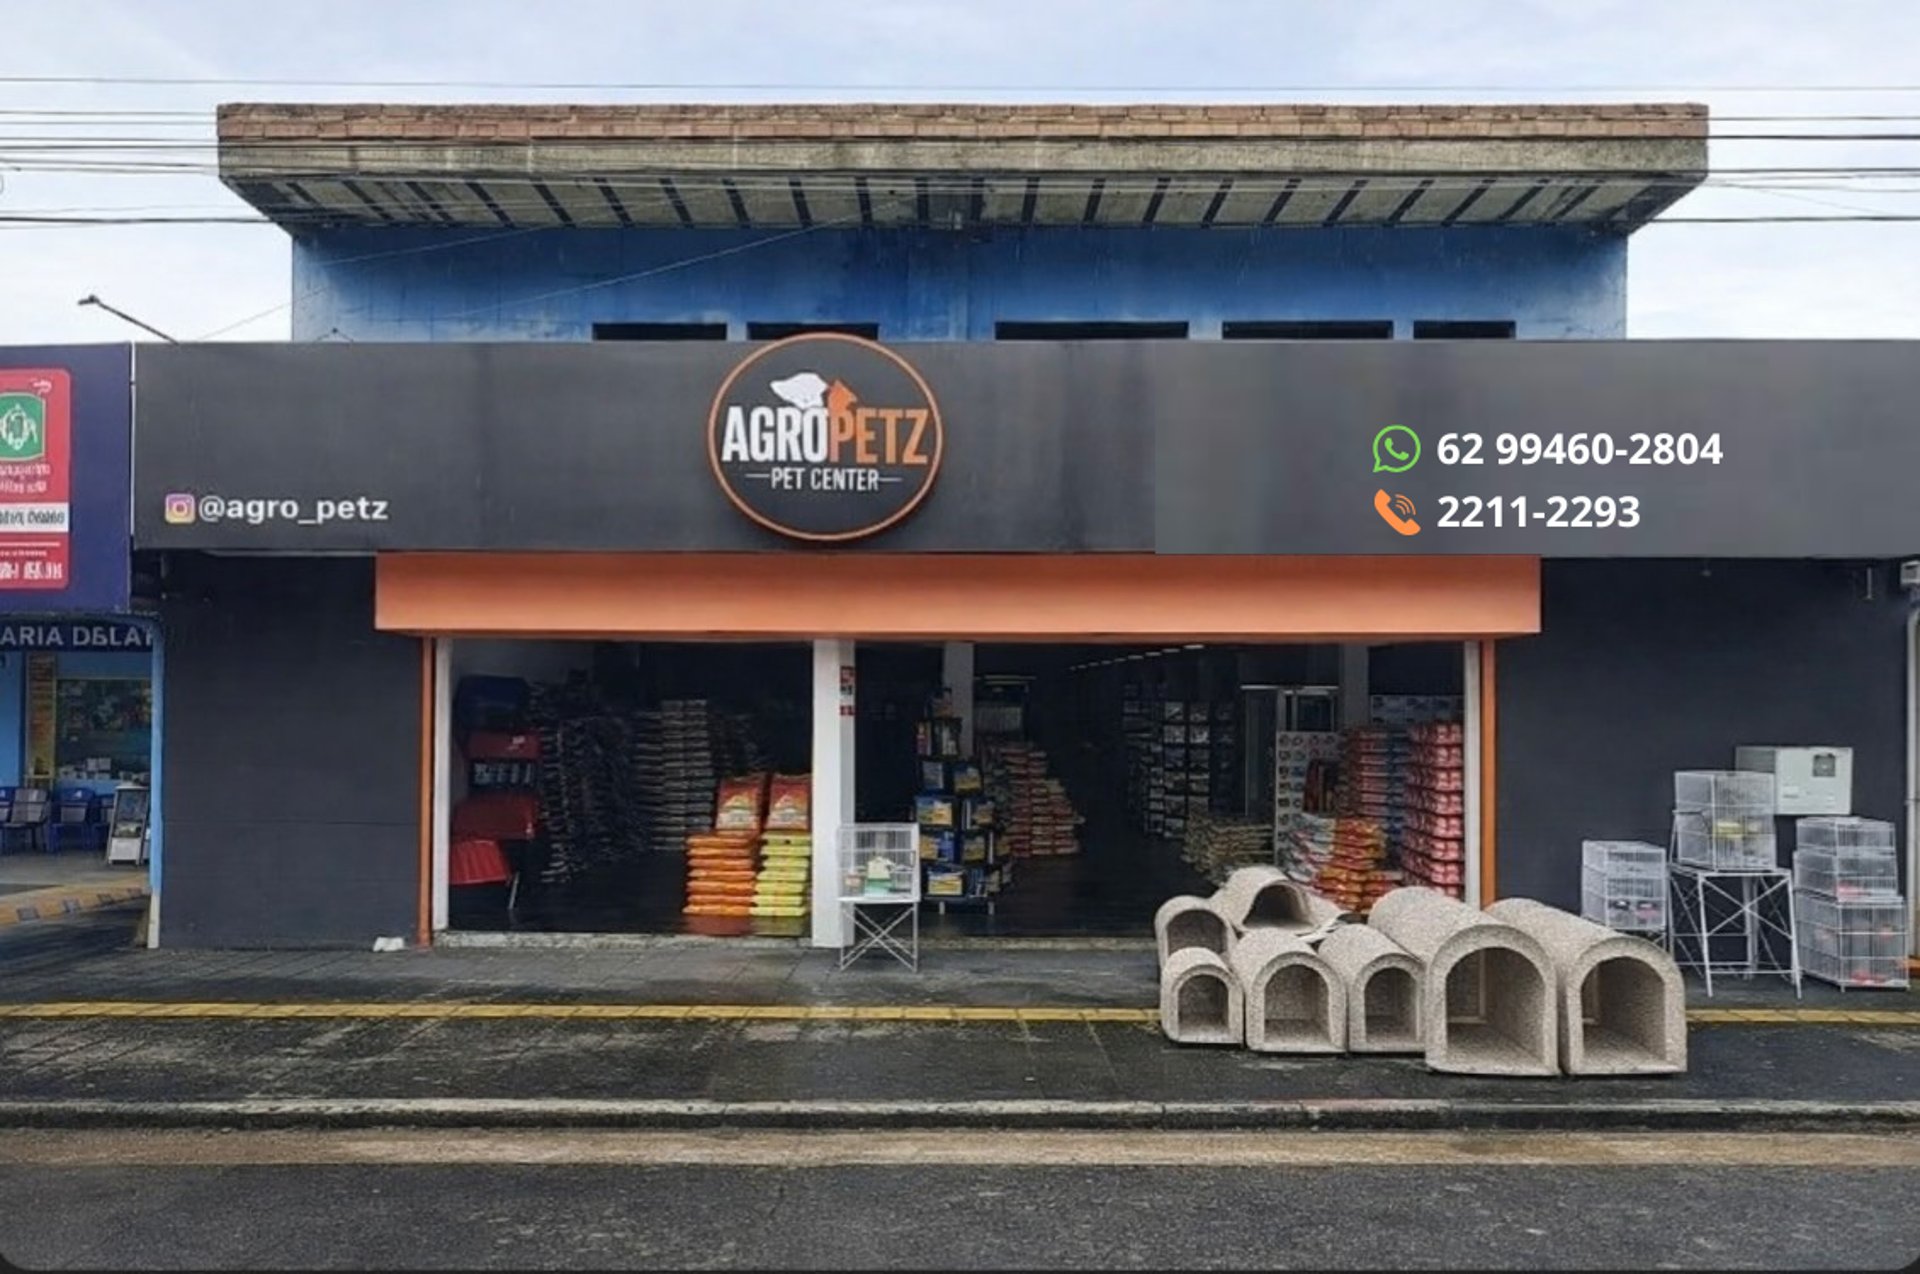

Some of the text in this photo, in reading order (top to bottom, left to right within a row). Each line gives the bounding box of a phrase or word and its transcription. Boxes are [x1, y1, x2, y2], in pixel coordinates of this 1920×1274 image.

[722, 405, 929, 464] AGROPETZ
[1437, 432, 1724, 465] 62 99460-2804
[770, 467, 879, 491] PET CENTER
[199, 494, 389, 525] @agro_petz
[1436, 495, 1641, 529] 2211-2293
